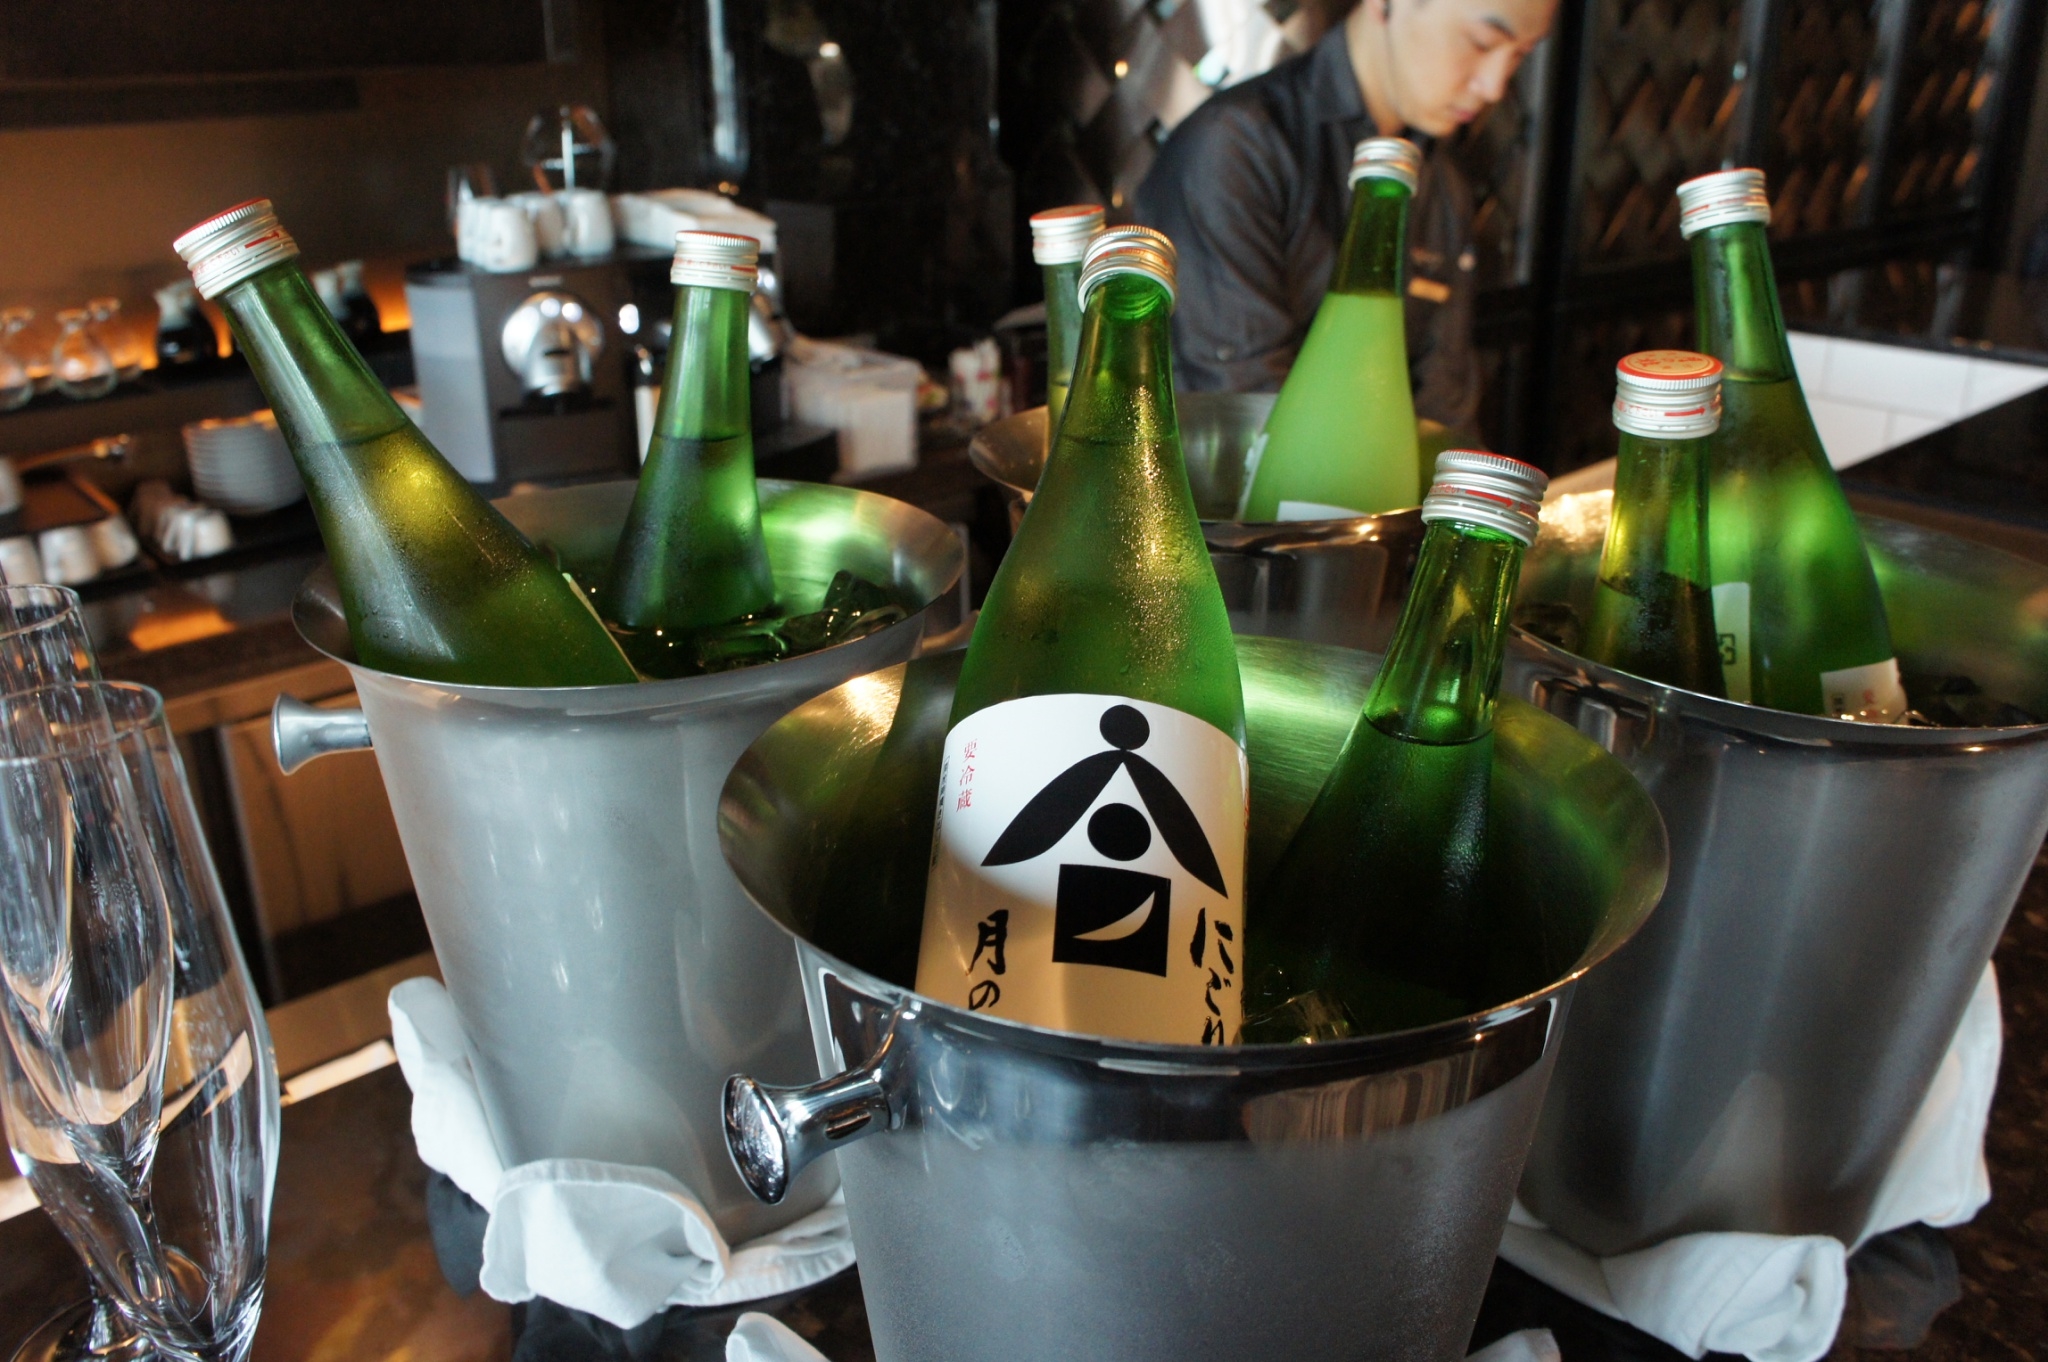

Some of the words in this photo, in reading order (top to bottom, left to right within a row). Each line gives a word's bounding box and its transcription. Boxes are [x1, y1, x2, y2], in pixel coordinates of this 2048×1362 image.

[956, 737, 978, 813] 要冷蔵
[965, 909, 1010, 1011] 月の
